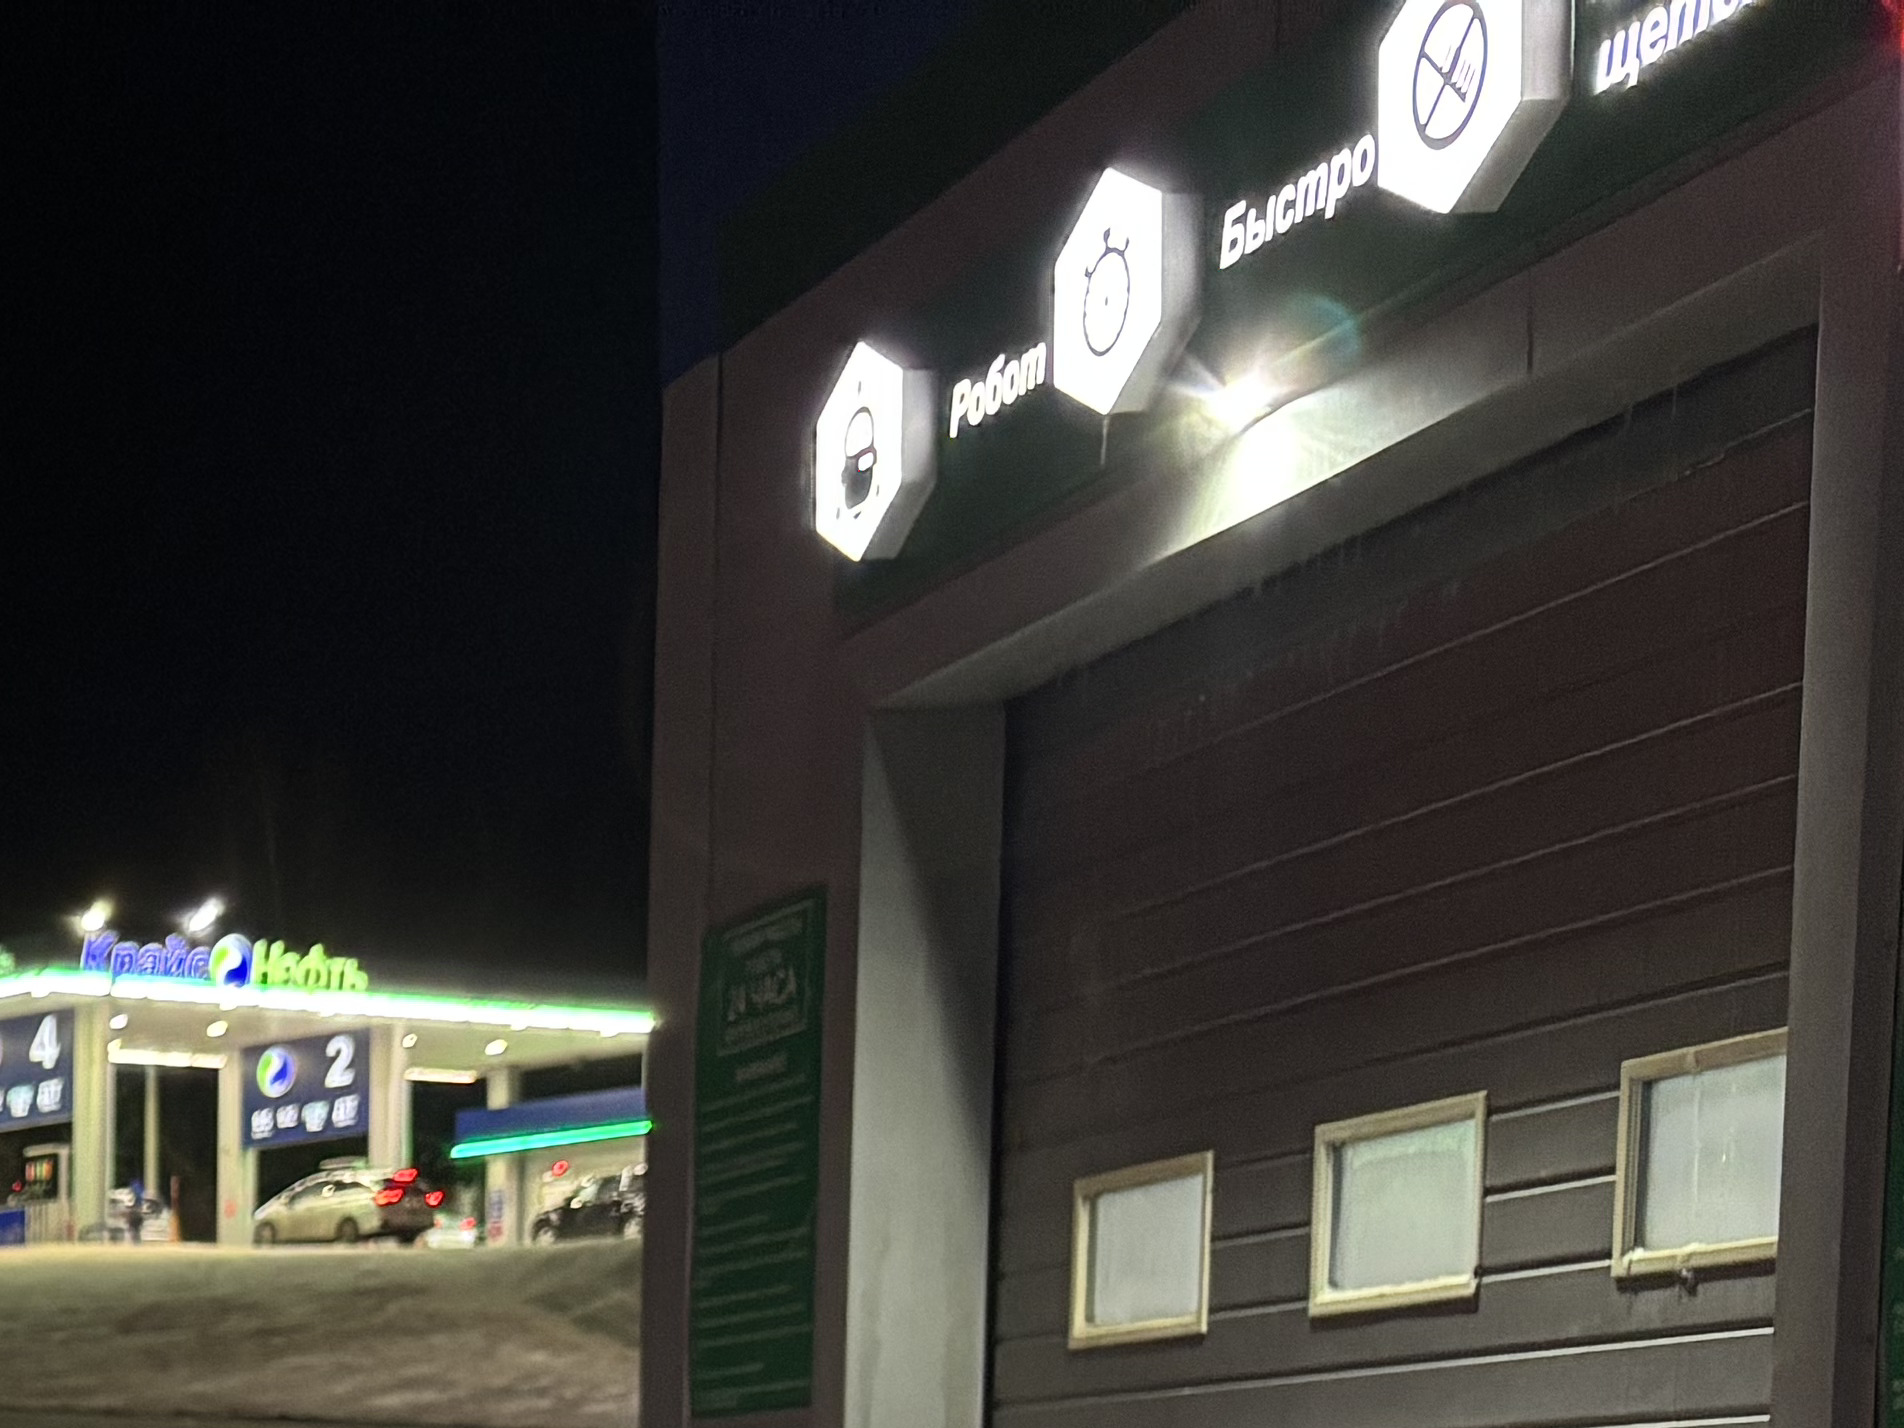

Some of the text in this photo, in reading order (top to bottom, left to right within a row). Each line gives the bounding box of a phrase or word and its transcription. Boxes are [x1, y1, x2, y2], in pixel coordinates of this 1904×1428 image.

[1219, 133, 1376, 270] Быстро
[949, 342, 1047, 440] Робот
[251, 938, 369, 992] Нефть
[29, 1014, 61, 1069] 4
[324, 1033, 356, 1088] 2
